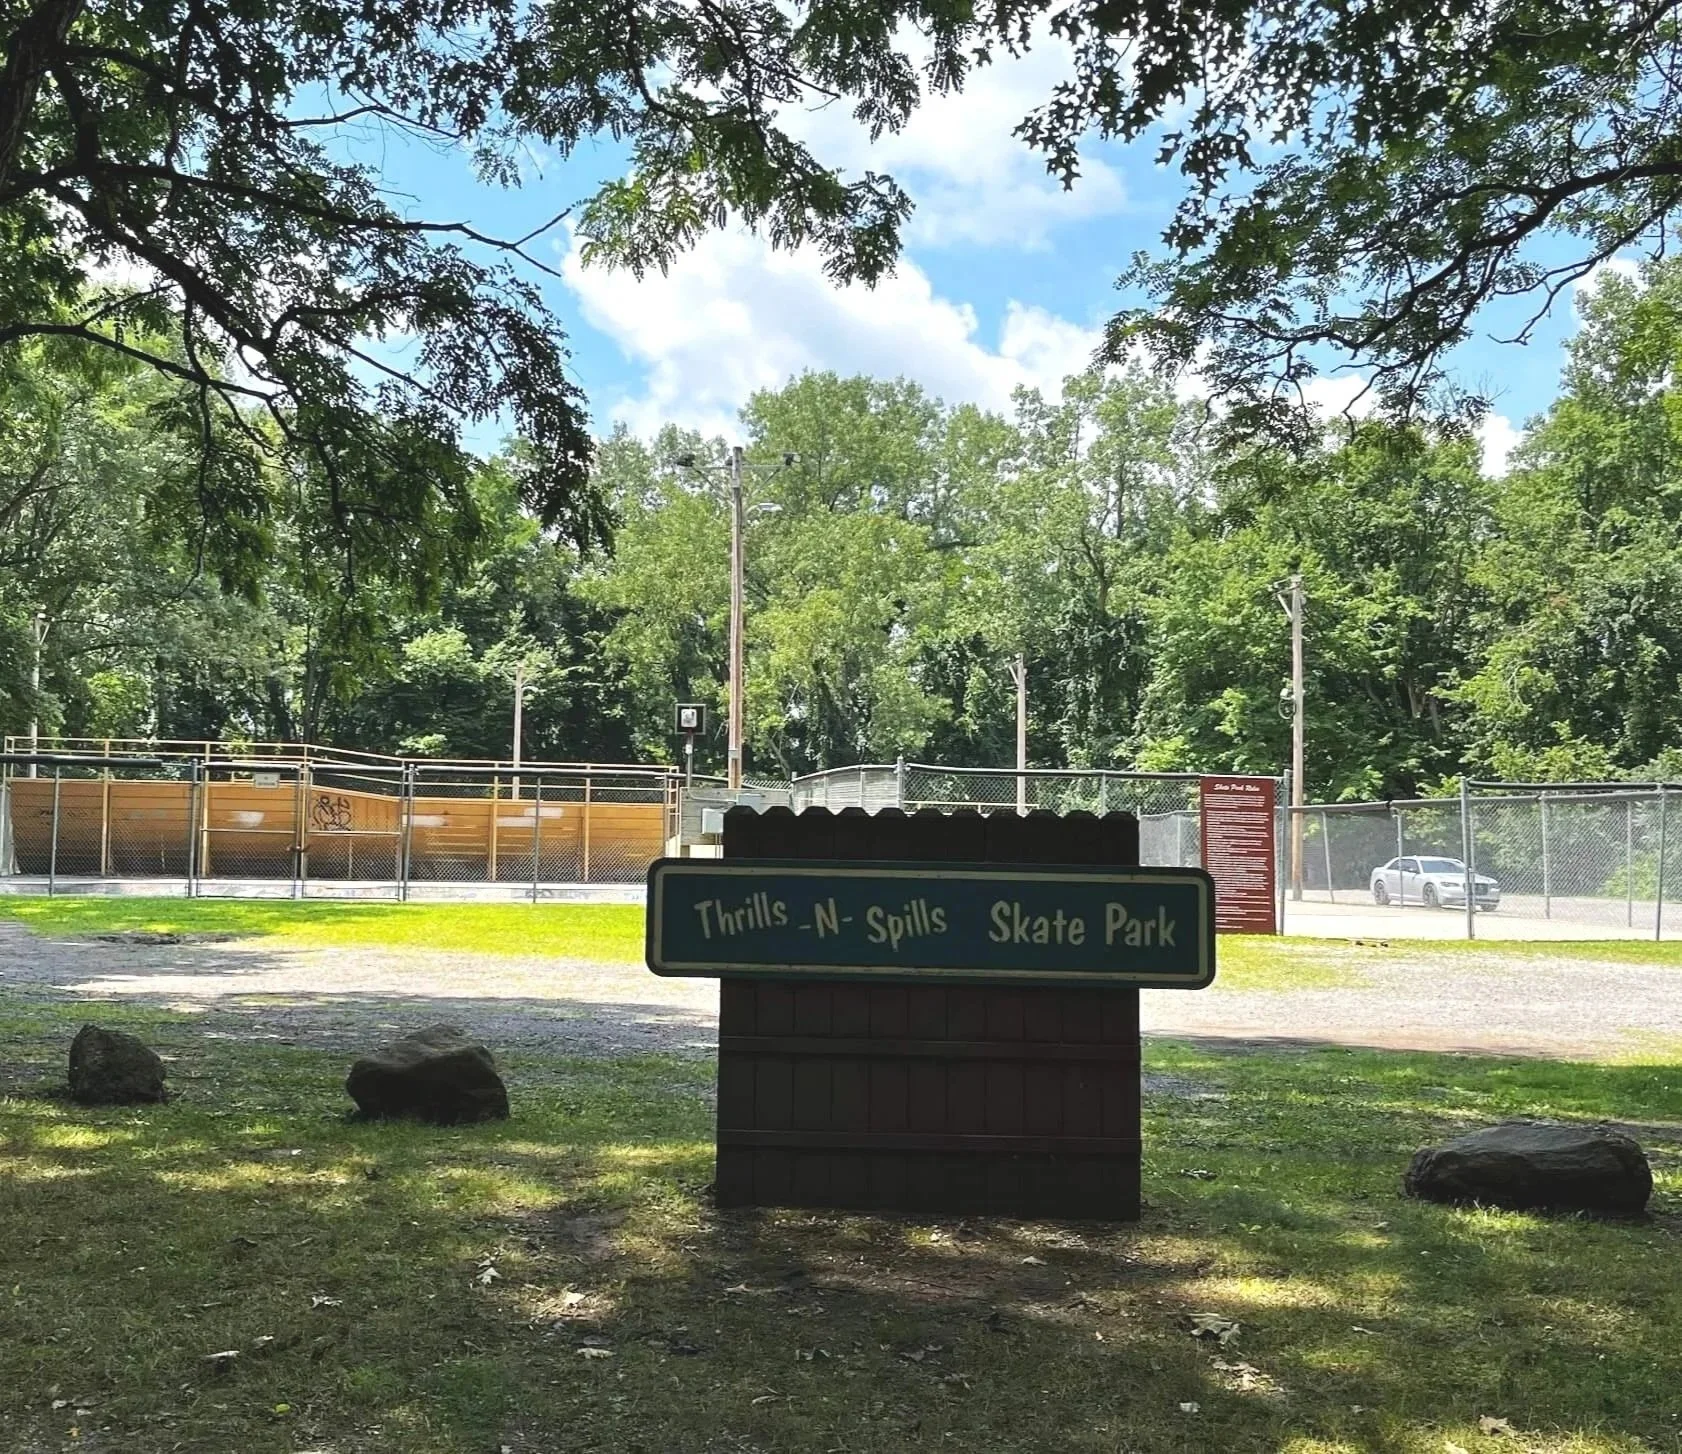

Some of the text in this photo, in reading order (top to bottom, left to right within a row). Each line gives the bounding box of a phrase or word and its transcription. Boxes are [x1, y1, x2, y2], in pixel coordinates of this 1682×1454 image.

[694, 892, 789, 940] Thrills
[867, 899, 948, 952] Spills
[988, 900, 1086, 947] Skate
[1105, 902, 1177, 948] Park
